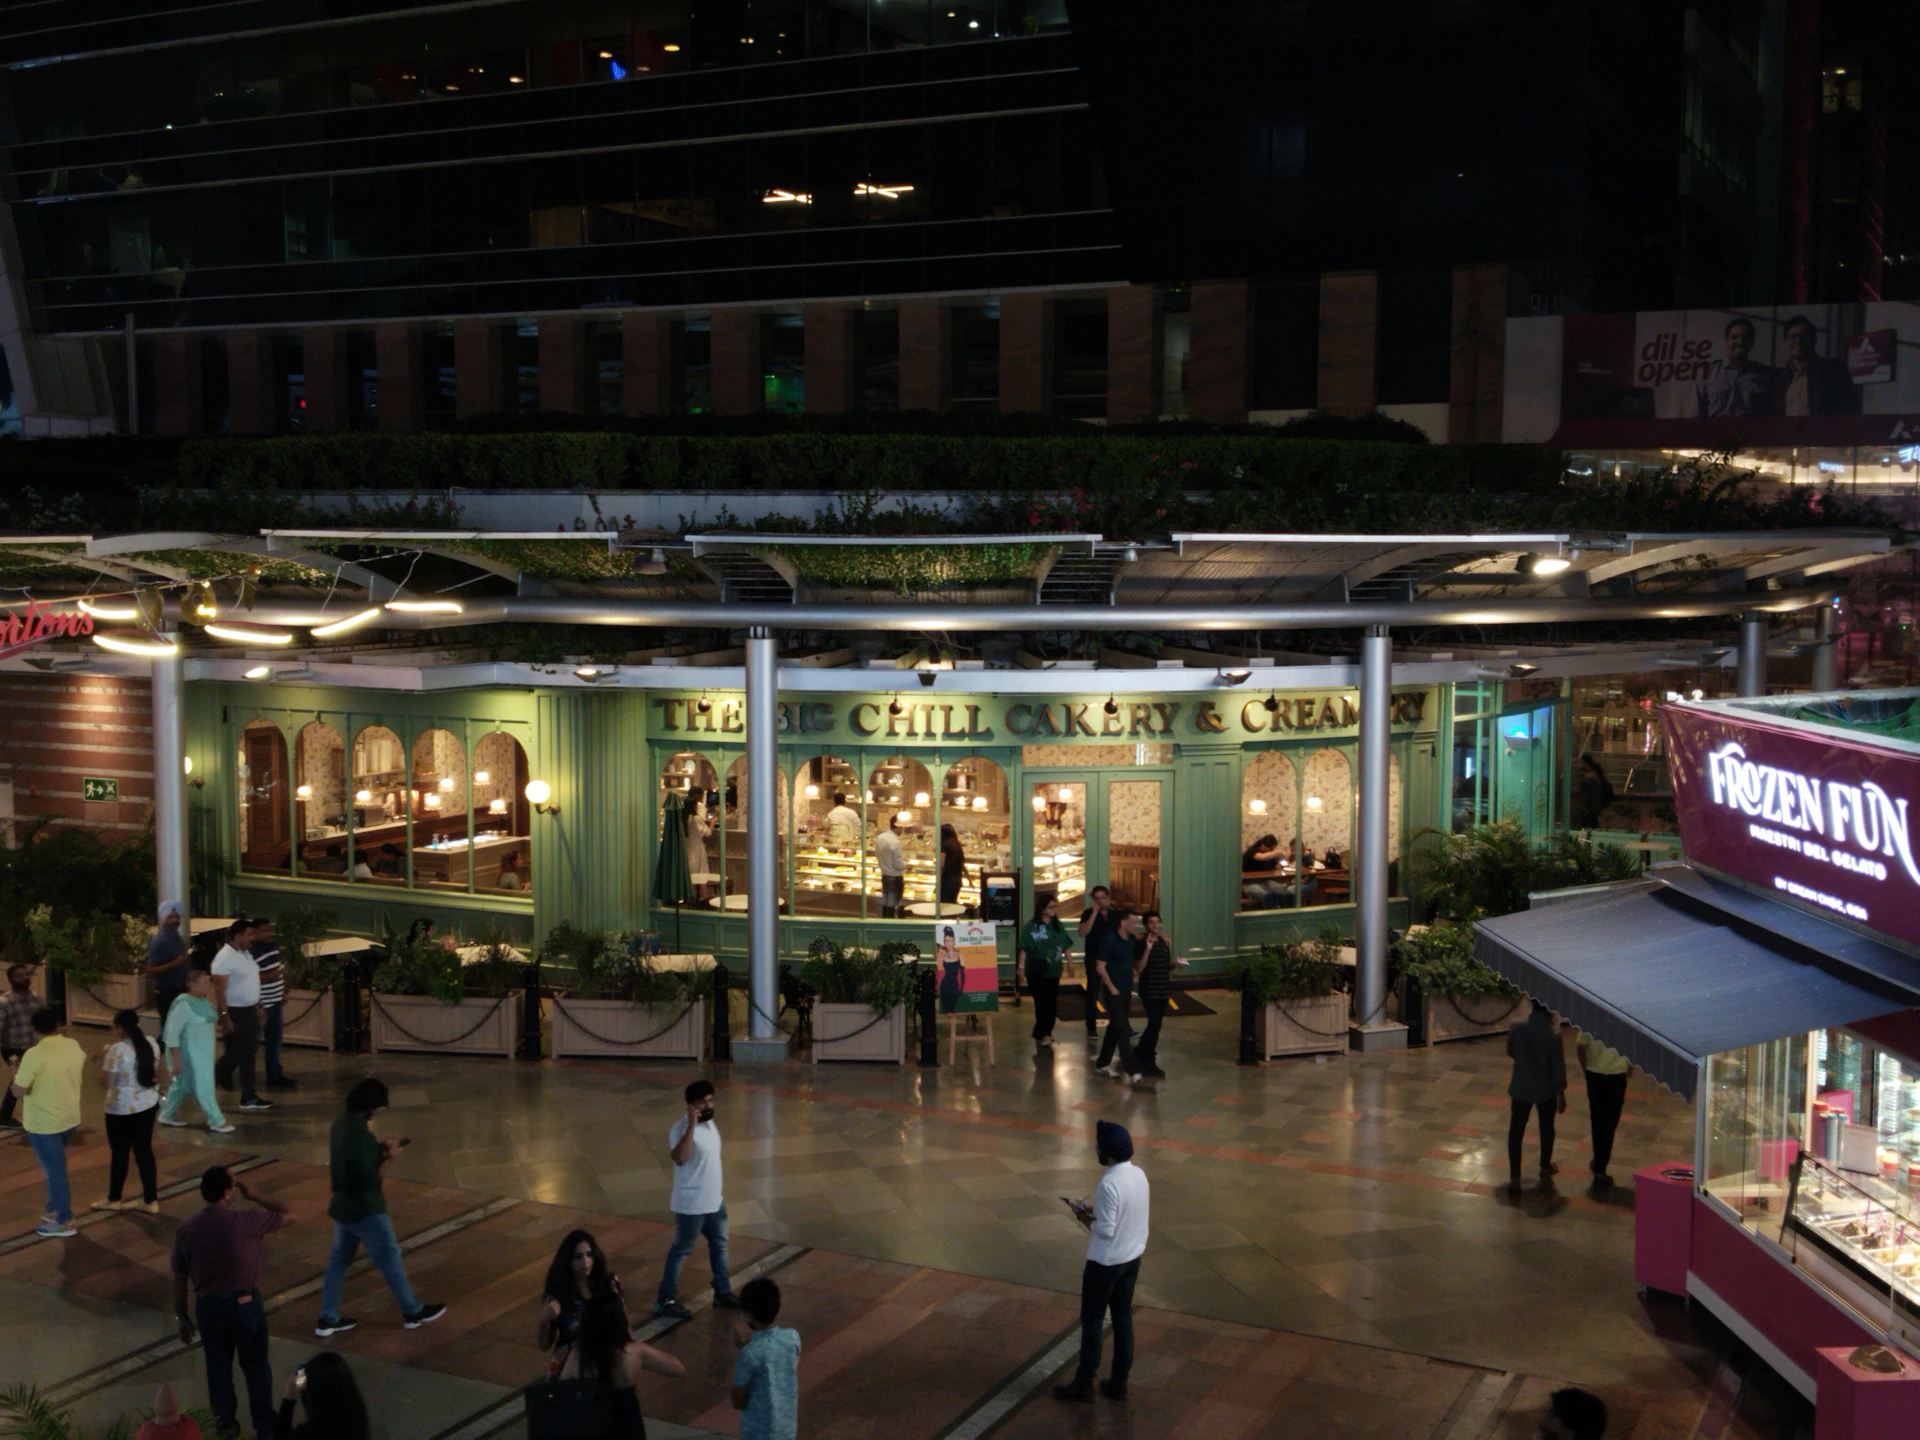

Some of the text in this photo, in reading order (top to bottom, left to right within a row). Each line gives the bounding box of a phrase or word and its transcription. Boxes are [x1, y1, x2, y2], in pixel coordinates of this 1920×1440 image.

[1641, 333, 1713, 362] dil se
[1638, 359, 1713, 387] open
[658, 698, 744, 733] THE
[850, 702, 992, 736] CHILL
[1005, 701, 1180, 737] CAKERY
[1195, 701, 1230, 732] &
[1241, 692, 1429, 733] CREAMRY
[1708, 742, 1920, 886] FROZEN FUN
[1803, 841, 1830, 862] DEL
[1832, 850, 1887, 880] GELATO
